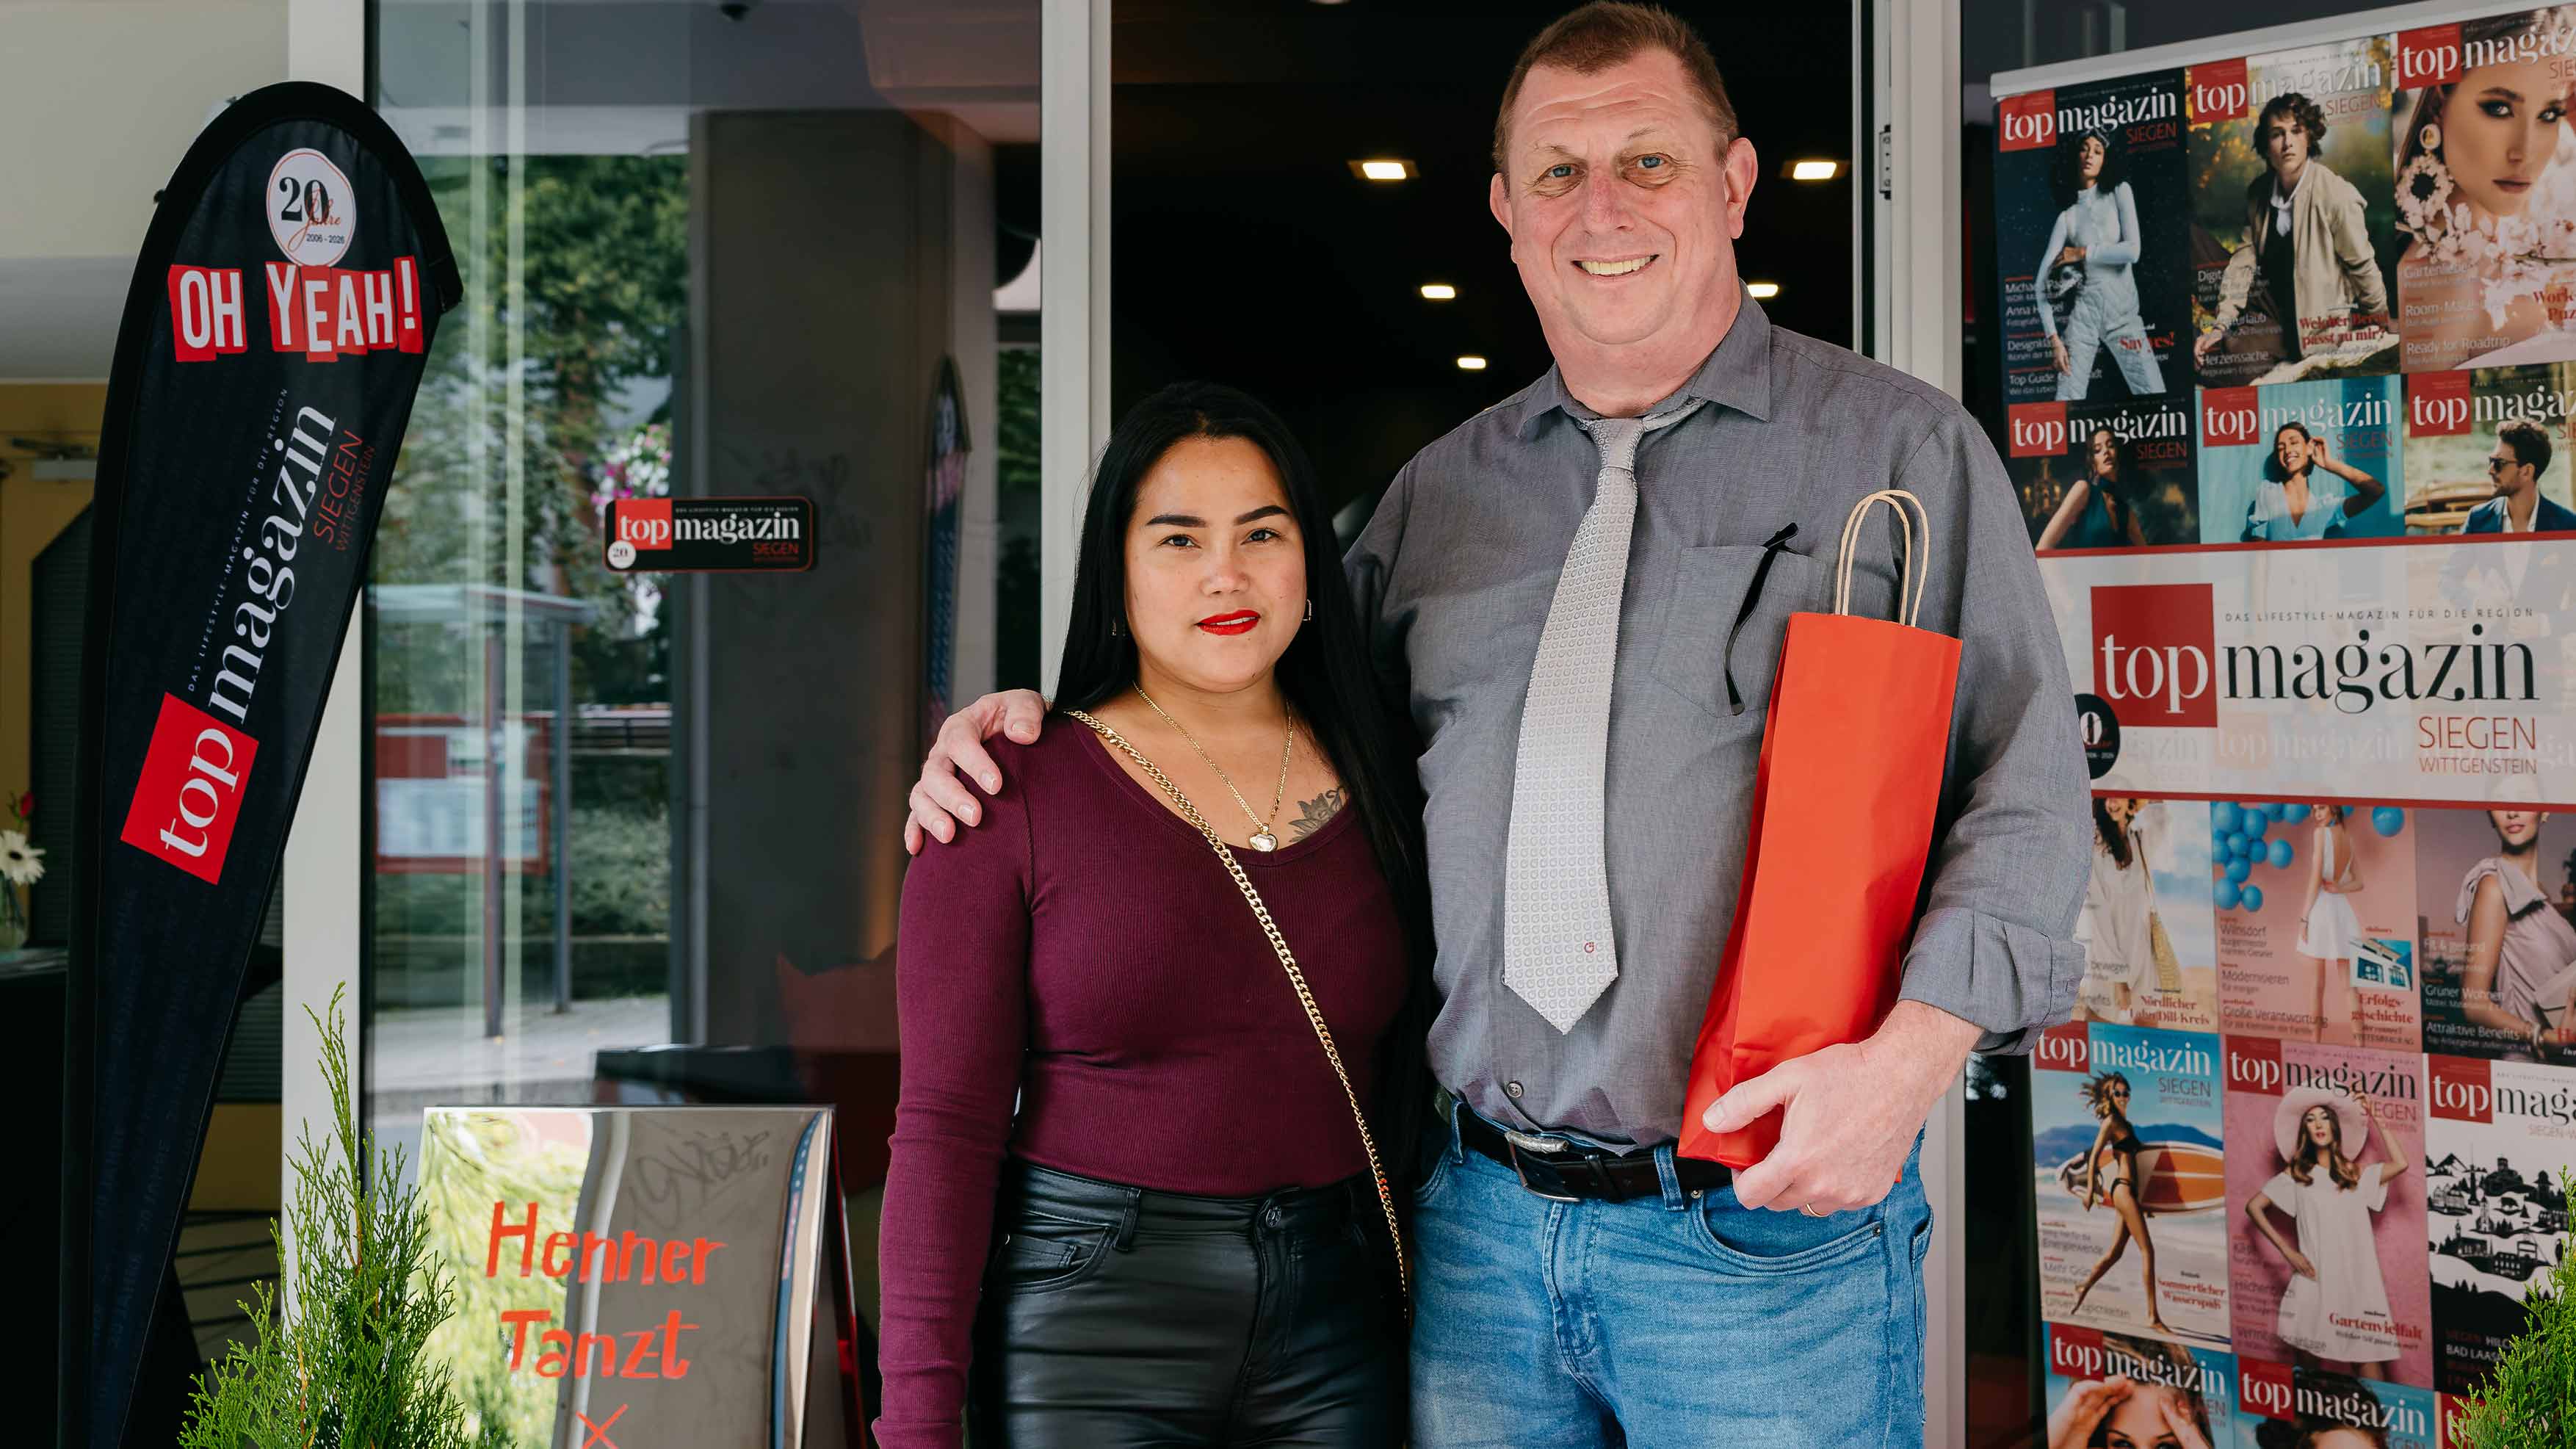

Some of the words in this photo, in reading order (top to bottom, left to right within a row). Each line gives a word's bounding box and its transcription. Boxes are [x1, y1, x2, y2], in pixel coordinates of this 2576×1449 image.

[2402, 45, 2459, 80] top
[2196, 82, 2246, 115] top
[2251, 54, 2381, 106] magazin
[2004, 112, 2055, 143] top
[2058, 87, 2177, 134] magazin
[2126, 121, 2177, 145] SIEGEN
[279, 176, 330, 223] 20
[179, 270, 244, 348] OH
[265, 259, 416, 353] YEAH!
[2302, 332, 2334, 350] passt
[2355, 326, 2386, 342] mir?
[2406, 342, 2439, 357] Ready
[267, 388, 288, 440] REGION
[2205, 406, 2257, 441] top
[2262, 392, 2392, 434] magazin
[2413, 394, 2468, 430] top
[2012, 417, 2064, 451] top
[2137, 441, 2188, 459] SIEGEN
[2335, 430, 2393, 450] SIEGEN
[313, 429, 363, 543] SIEGEN
[619, 515, 670, 546] top
[673, 511, 800, 545] magazin
[159, 728, 239, 858] top
[208, 405, 337, 725] magazin
[2225, 613, 2250, 622] DAS
[2257, 610, 2400, 622] LIFESTYLE-MAGAZIN
[2444, 608, 2468, 618] DIE
[2477, 607, 2533, 618] REGION
[2100, 633, 2209, 714] top
[2221, 623, 2541, 715] magazin
[2419, 716, 2537, 750] SIEGEN
[2419, 756, 2538, 776] WITTGENSTEIN
[2038, 1035, 2087, 1068] top
[2093, 1039, 2211, 1076] magazin
[2232, 1051, 2279, 1090] top
[2285, 1061, 2418, 1100] magazin
[2158, 1077, 2212, 1098] SIEGEN
[2432, 1074, 2489, 1117] top
[485, 1201, 728, 1285] Henner
[499, 1309, 700, 1380] Tanzt
[2445, 1343, 2468, 1358] BAD
[2055, 1336, 2102, 1376] top
[2106, 1354, 2226, 1397] magazin
[2242, 1372, 2291, 1414] top
[2296, 1392, 2425, 1437] magazin
